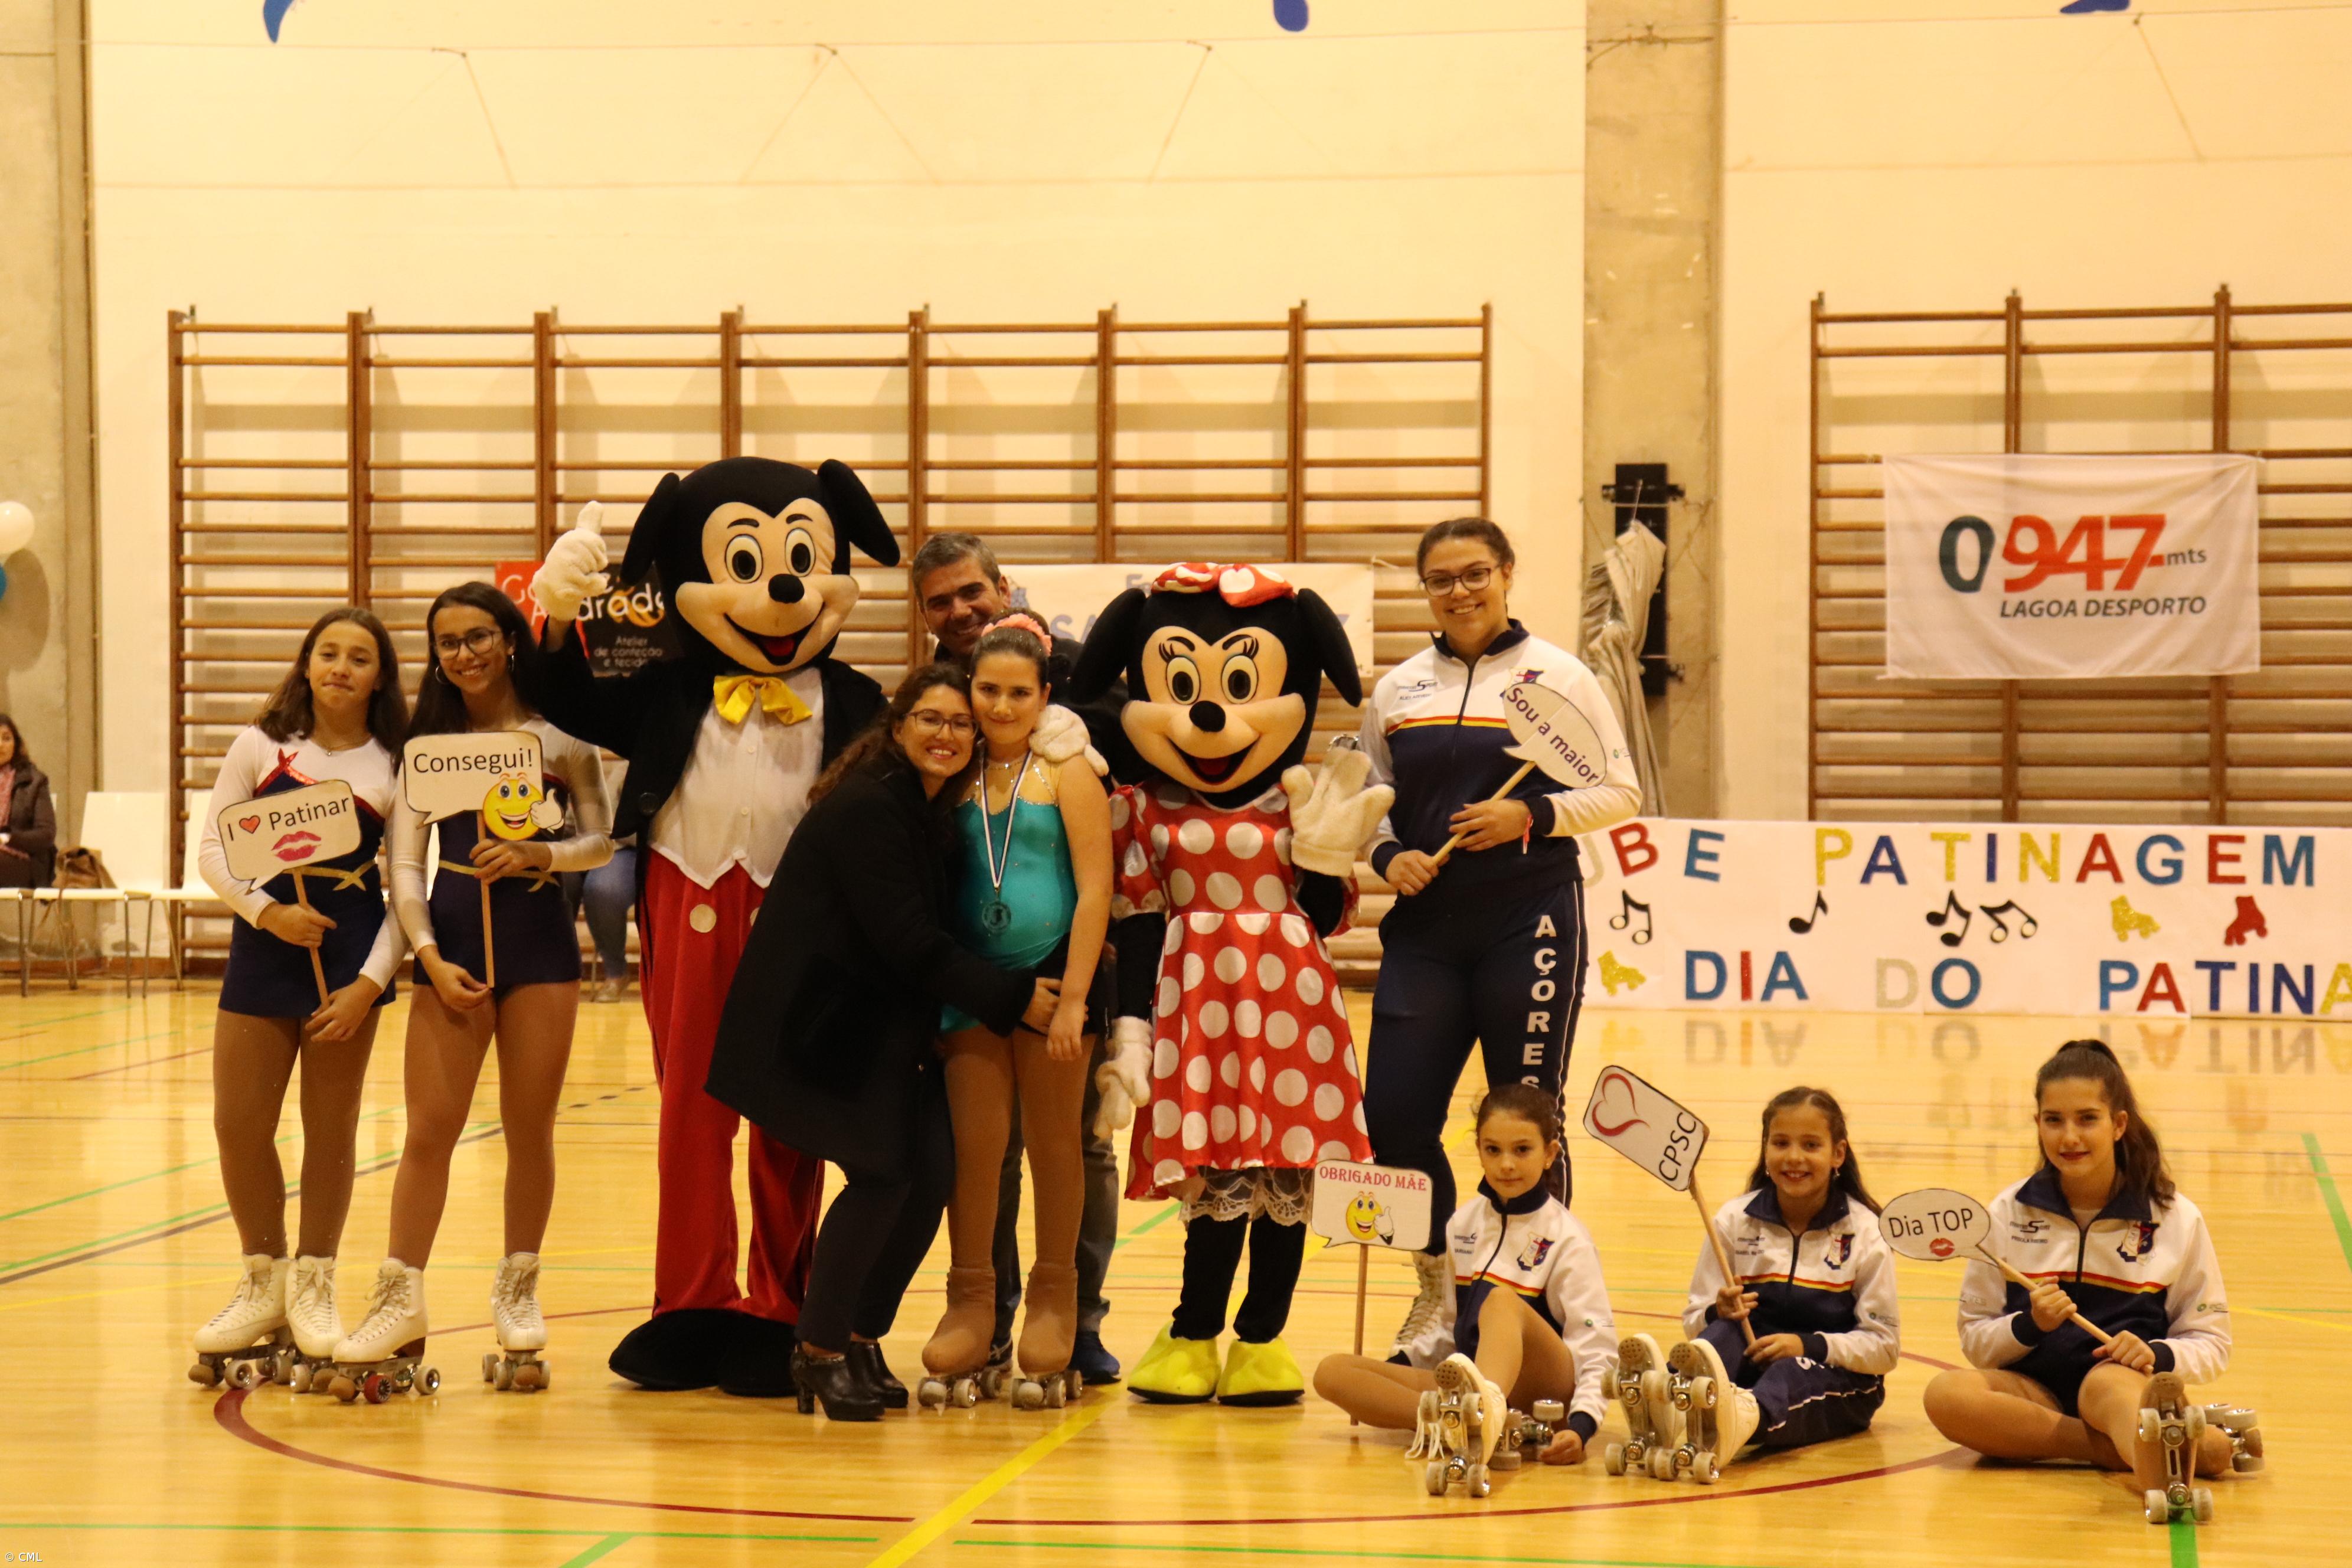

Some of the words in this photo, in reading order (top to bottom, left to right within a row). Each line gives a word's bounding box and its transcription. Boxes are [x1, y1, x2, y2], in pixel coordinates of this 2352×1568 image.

[2167, 547, 2207, 566] mts
[2001, 599, 2077, 619] LAGOA
[2085, 596, 2207, 617] DESPORTO
[1507, 688, 1540, 723] Sou
[1537, 722, 1550, 736] a
[1550, 734, 1599, 783] maior
[413, 747, 534, 775] Consegui!
[227, 822, 234, 841] I
[268, 795, 350, 831] Patinar
[1815, 827, 2315, 887] PATINAGEM
[1685, 949, 1808, 1001] DIA
[1875, 957, 1982, 1010] DO
[1658, 1112, 1697, 1182] CPSC
[1319, 1167, 1391, 1187] OBRIGADO
[1395, 1173, 1427, 1191] MÃE
[1889, 1216, 1923, 1238] Dia
[1928, 1207, 1974, 1234] TOP
